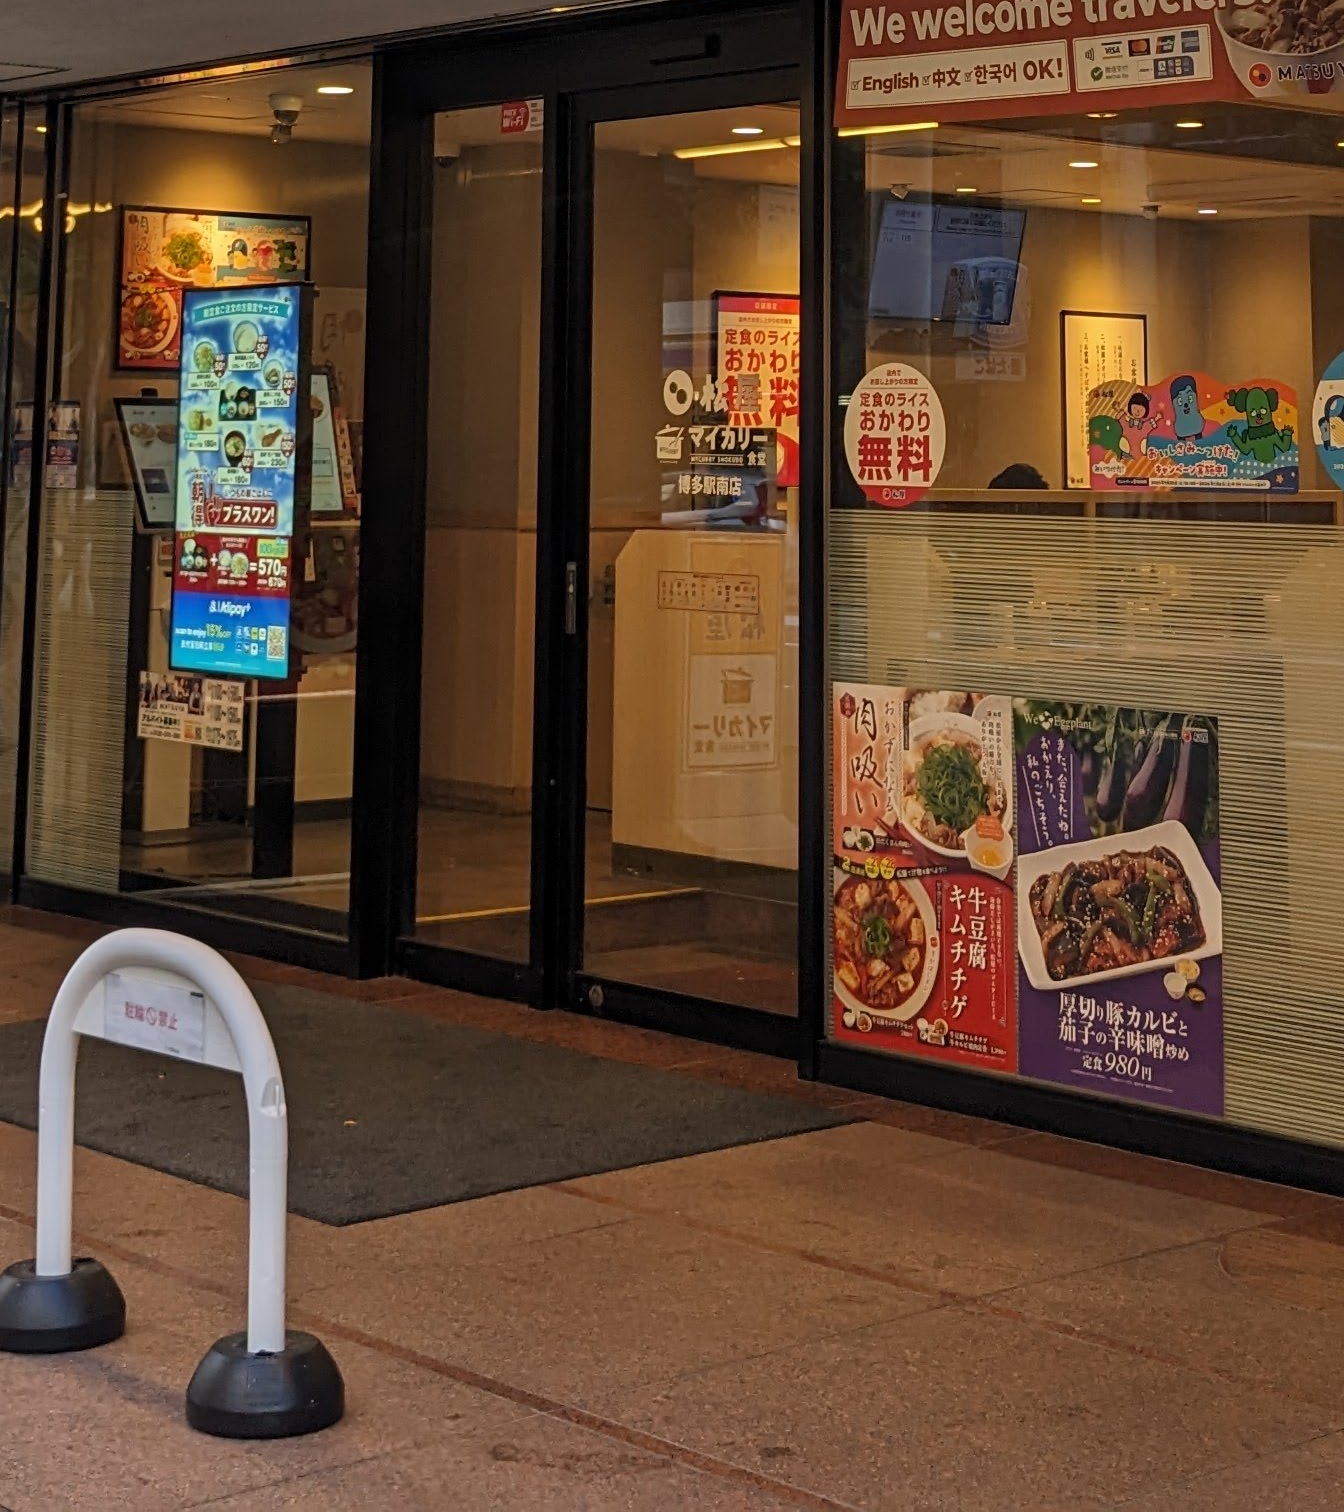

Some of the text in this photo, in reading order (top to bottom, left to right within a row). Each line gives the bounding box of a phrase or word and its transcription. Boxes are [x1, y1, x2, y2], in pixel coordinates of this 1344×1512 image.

[849, 5, 906, 47] We
[862, 58, 1064, 94] English 中文 한국어 OK!
[859, 392, 930, 408] 定食のライス
[688, 426, 768, 451] マイカリー
[859, 409, 931, 433] おかわり
[746, 451, 767, 466] 食堂
[857, 434, 933, 483] 無料
[678, 474, 742, 496] 博多駅南店
[1023, 712, 1092, 731] We Eggplant
[967, 886, 988, 970] 牛豆腐
[949, 884, 968, 1020] キムチチゲ
[1059, 991, 1188, 1037] 厚切り豚カルビと
[1058, 1015, 1190, 1062] 茄子の辛味噌炒め
